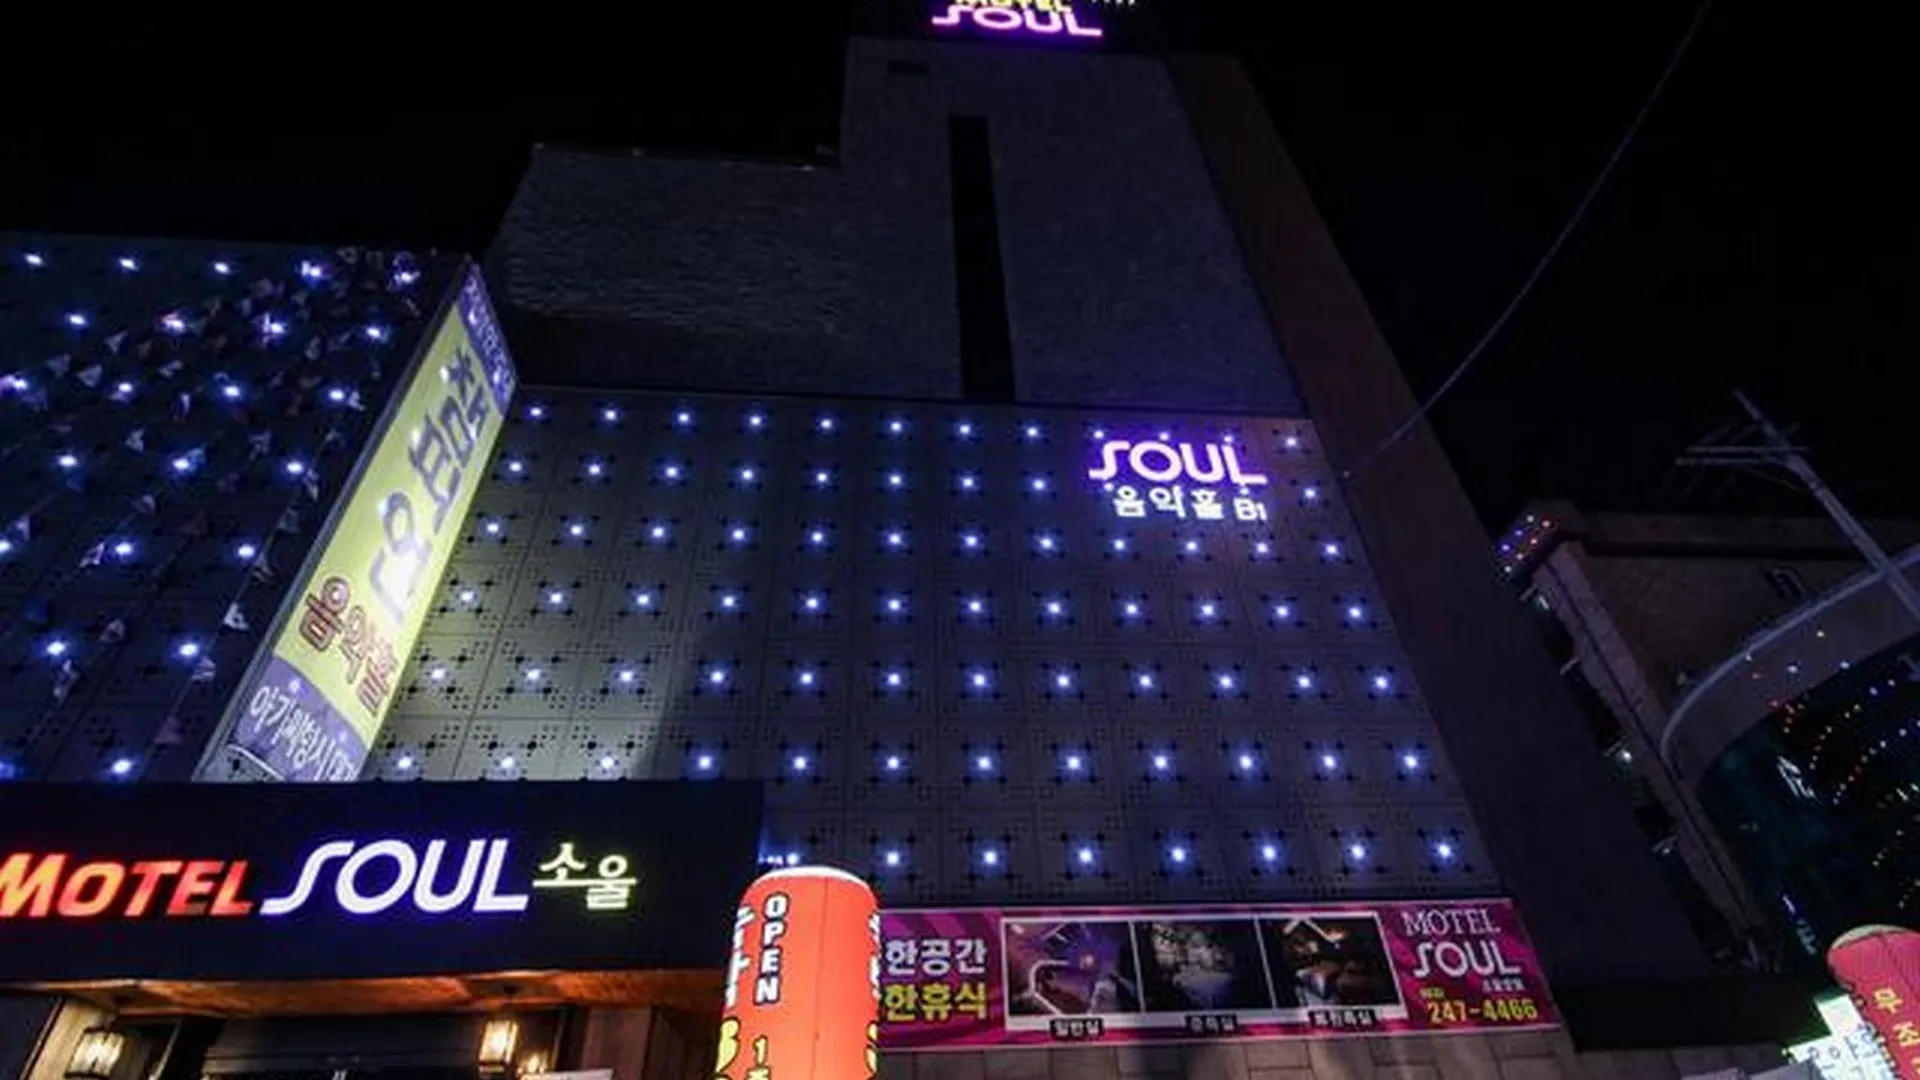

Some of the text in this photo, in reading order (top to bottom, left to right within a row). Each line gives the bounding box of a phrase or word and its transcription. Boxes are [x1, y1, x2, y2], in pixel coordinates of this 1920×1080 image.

[931, 5, 1103, 37] SOUL
[1088, 440, 1268, 484] SOUL
[0, 838, 637, 918] MOTEL SOUL 소울
[1401, 908, 1501, 936] MOTEL
[754, 894, 788, 1003] OPEN
[1412, 939, 1523, 977] SOUL
